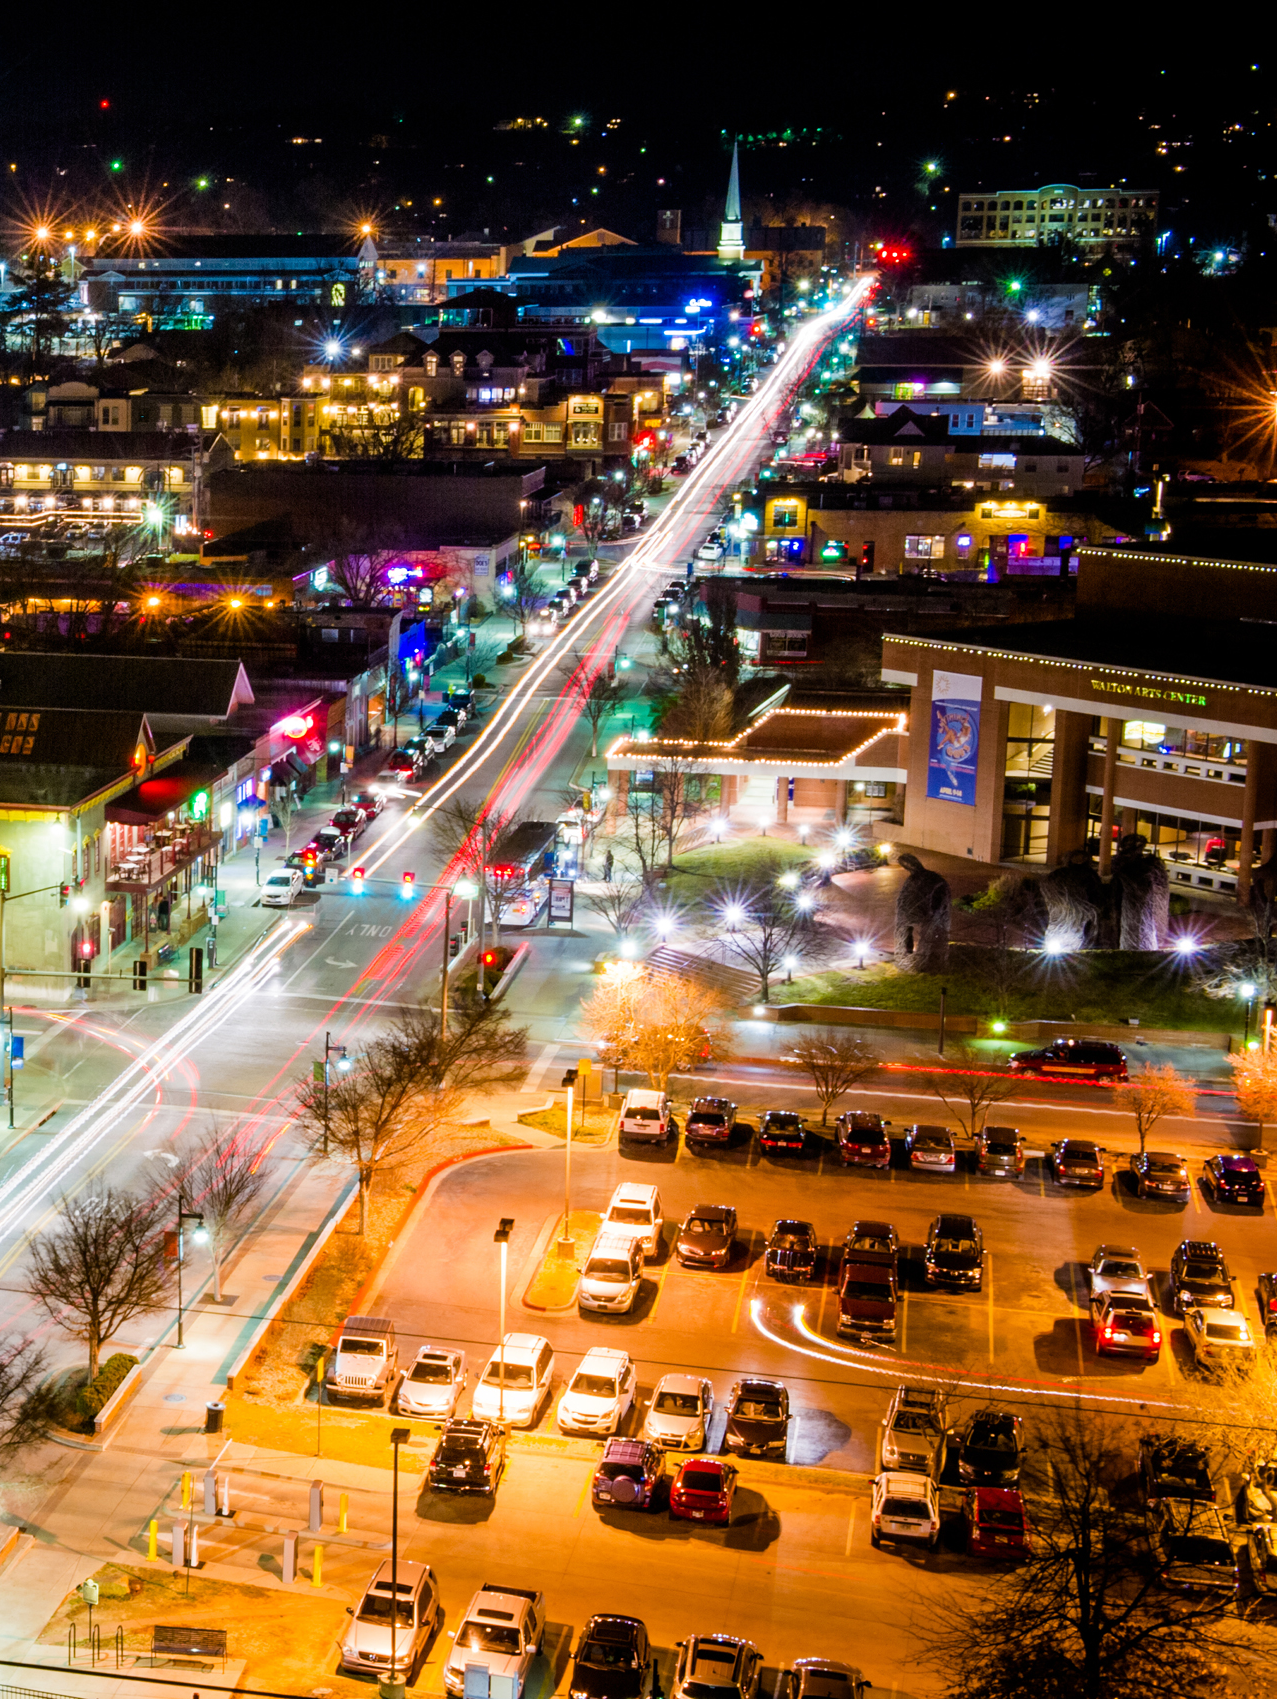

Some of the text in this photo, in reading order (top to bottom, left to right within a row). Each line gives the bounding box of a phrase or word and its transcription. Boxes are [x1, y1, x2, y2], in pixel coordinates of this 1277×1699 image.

[1091, 679, 1207, 706] WALTON ARTS CENTER
[345, 924, 393, 938] ONLY
